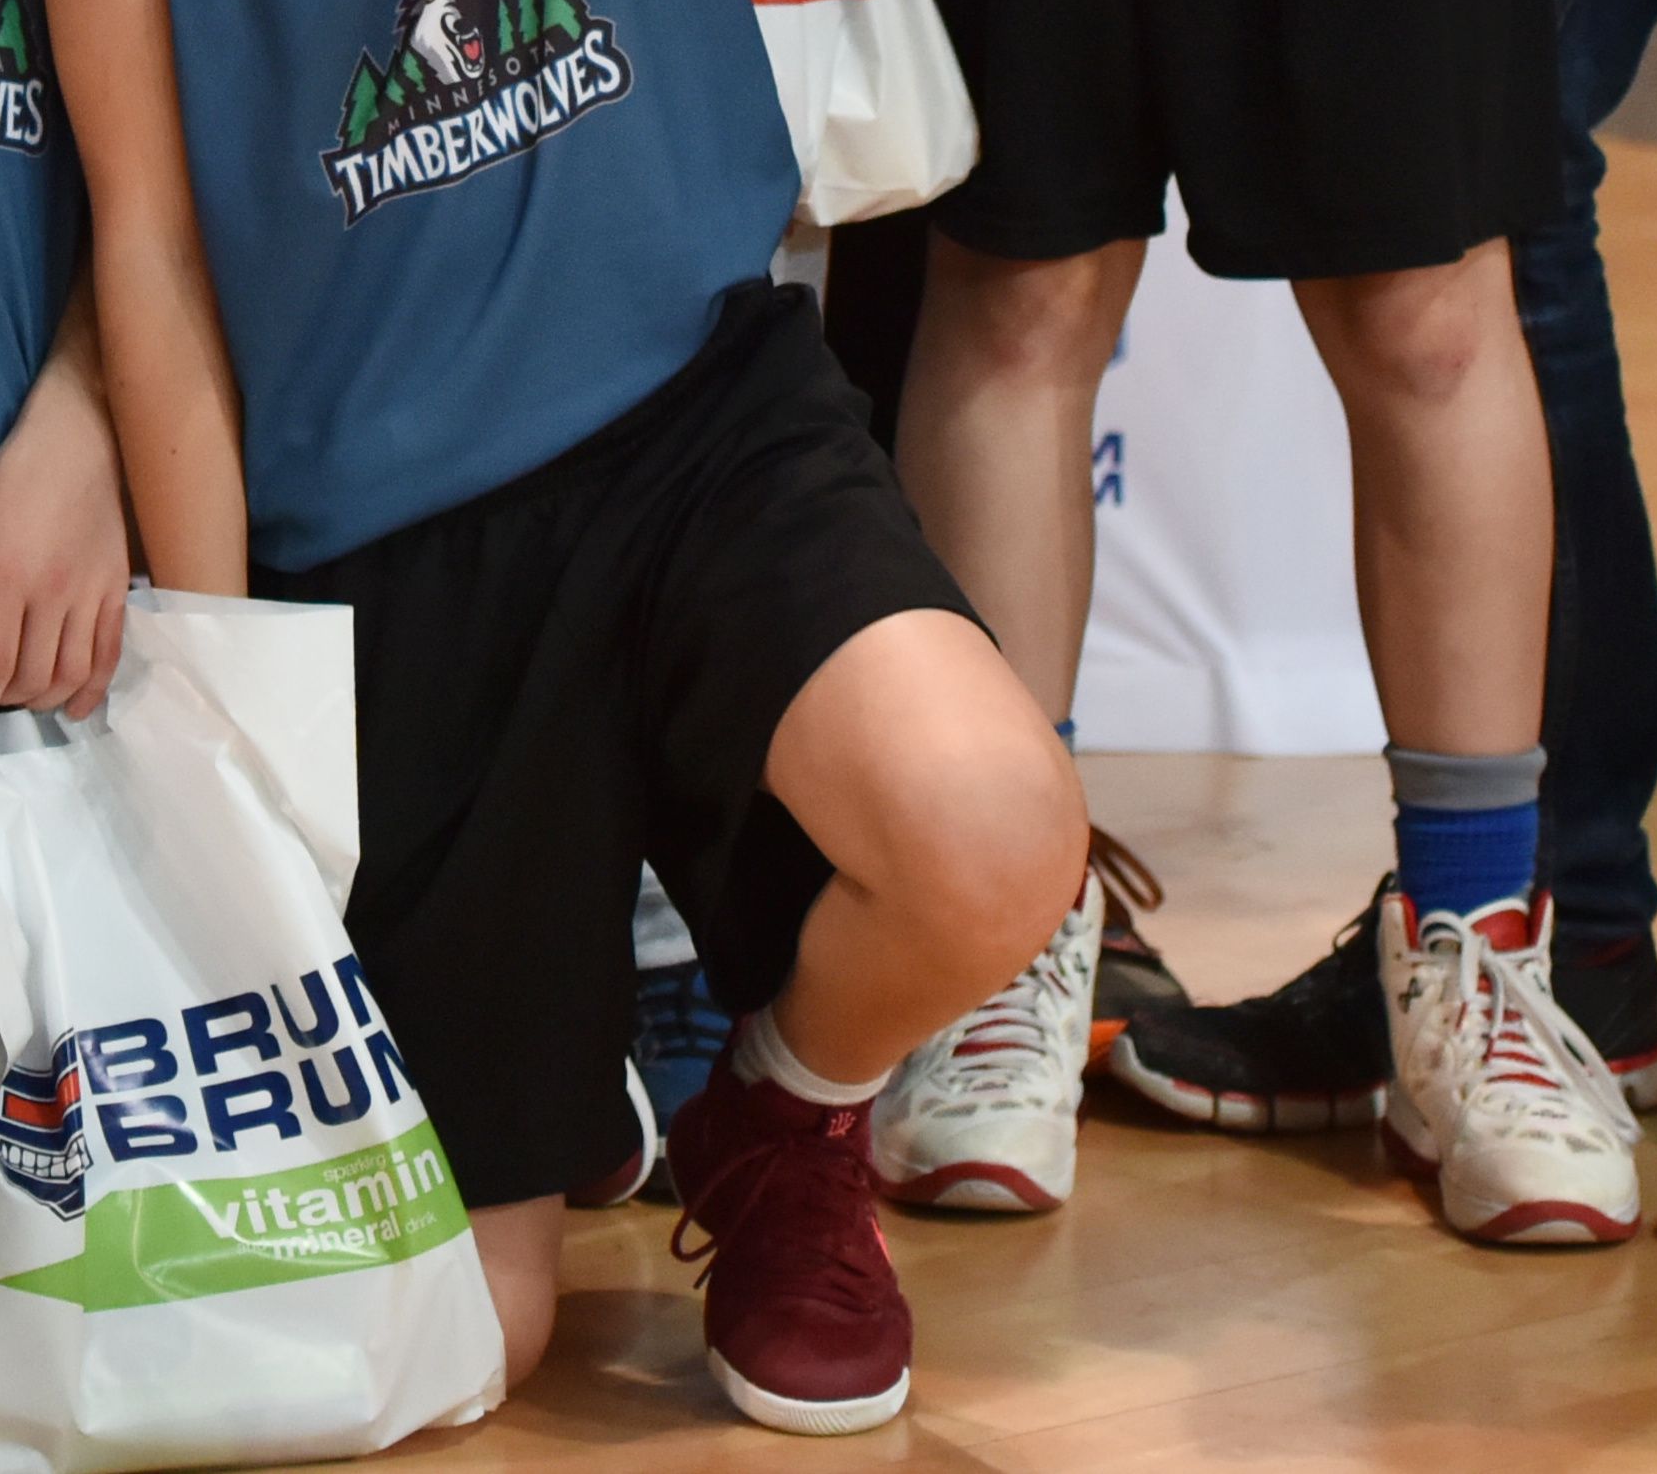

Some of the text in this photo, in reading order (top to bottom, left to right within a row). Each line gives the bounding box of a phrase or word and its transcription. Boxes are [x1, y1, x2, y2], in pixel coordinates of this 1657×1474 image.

[335, 30, 622, 214] TIMBERWOLVES
[197, 1149, 445, 1239] vitamin
[272, 1210, 401, 1261] mineral
